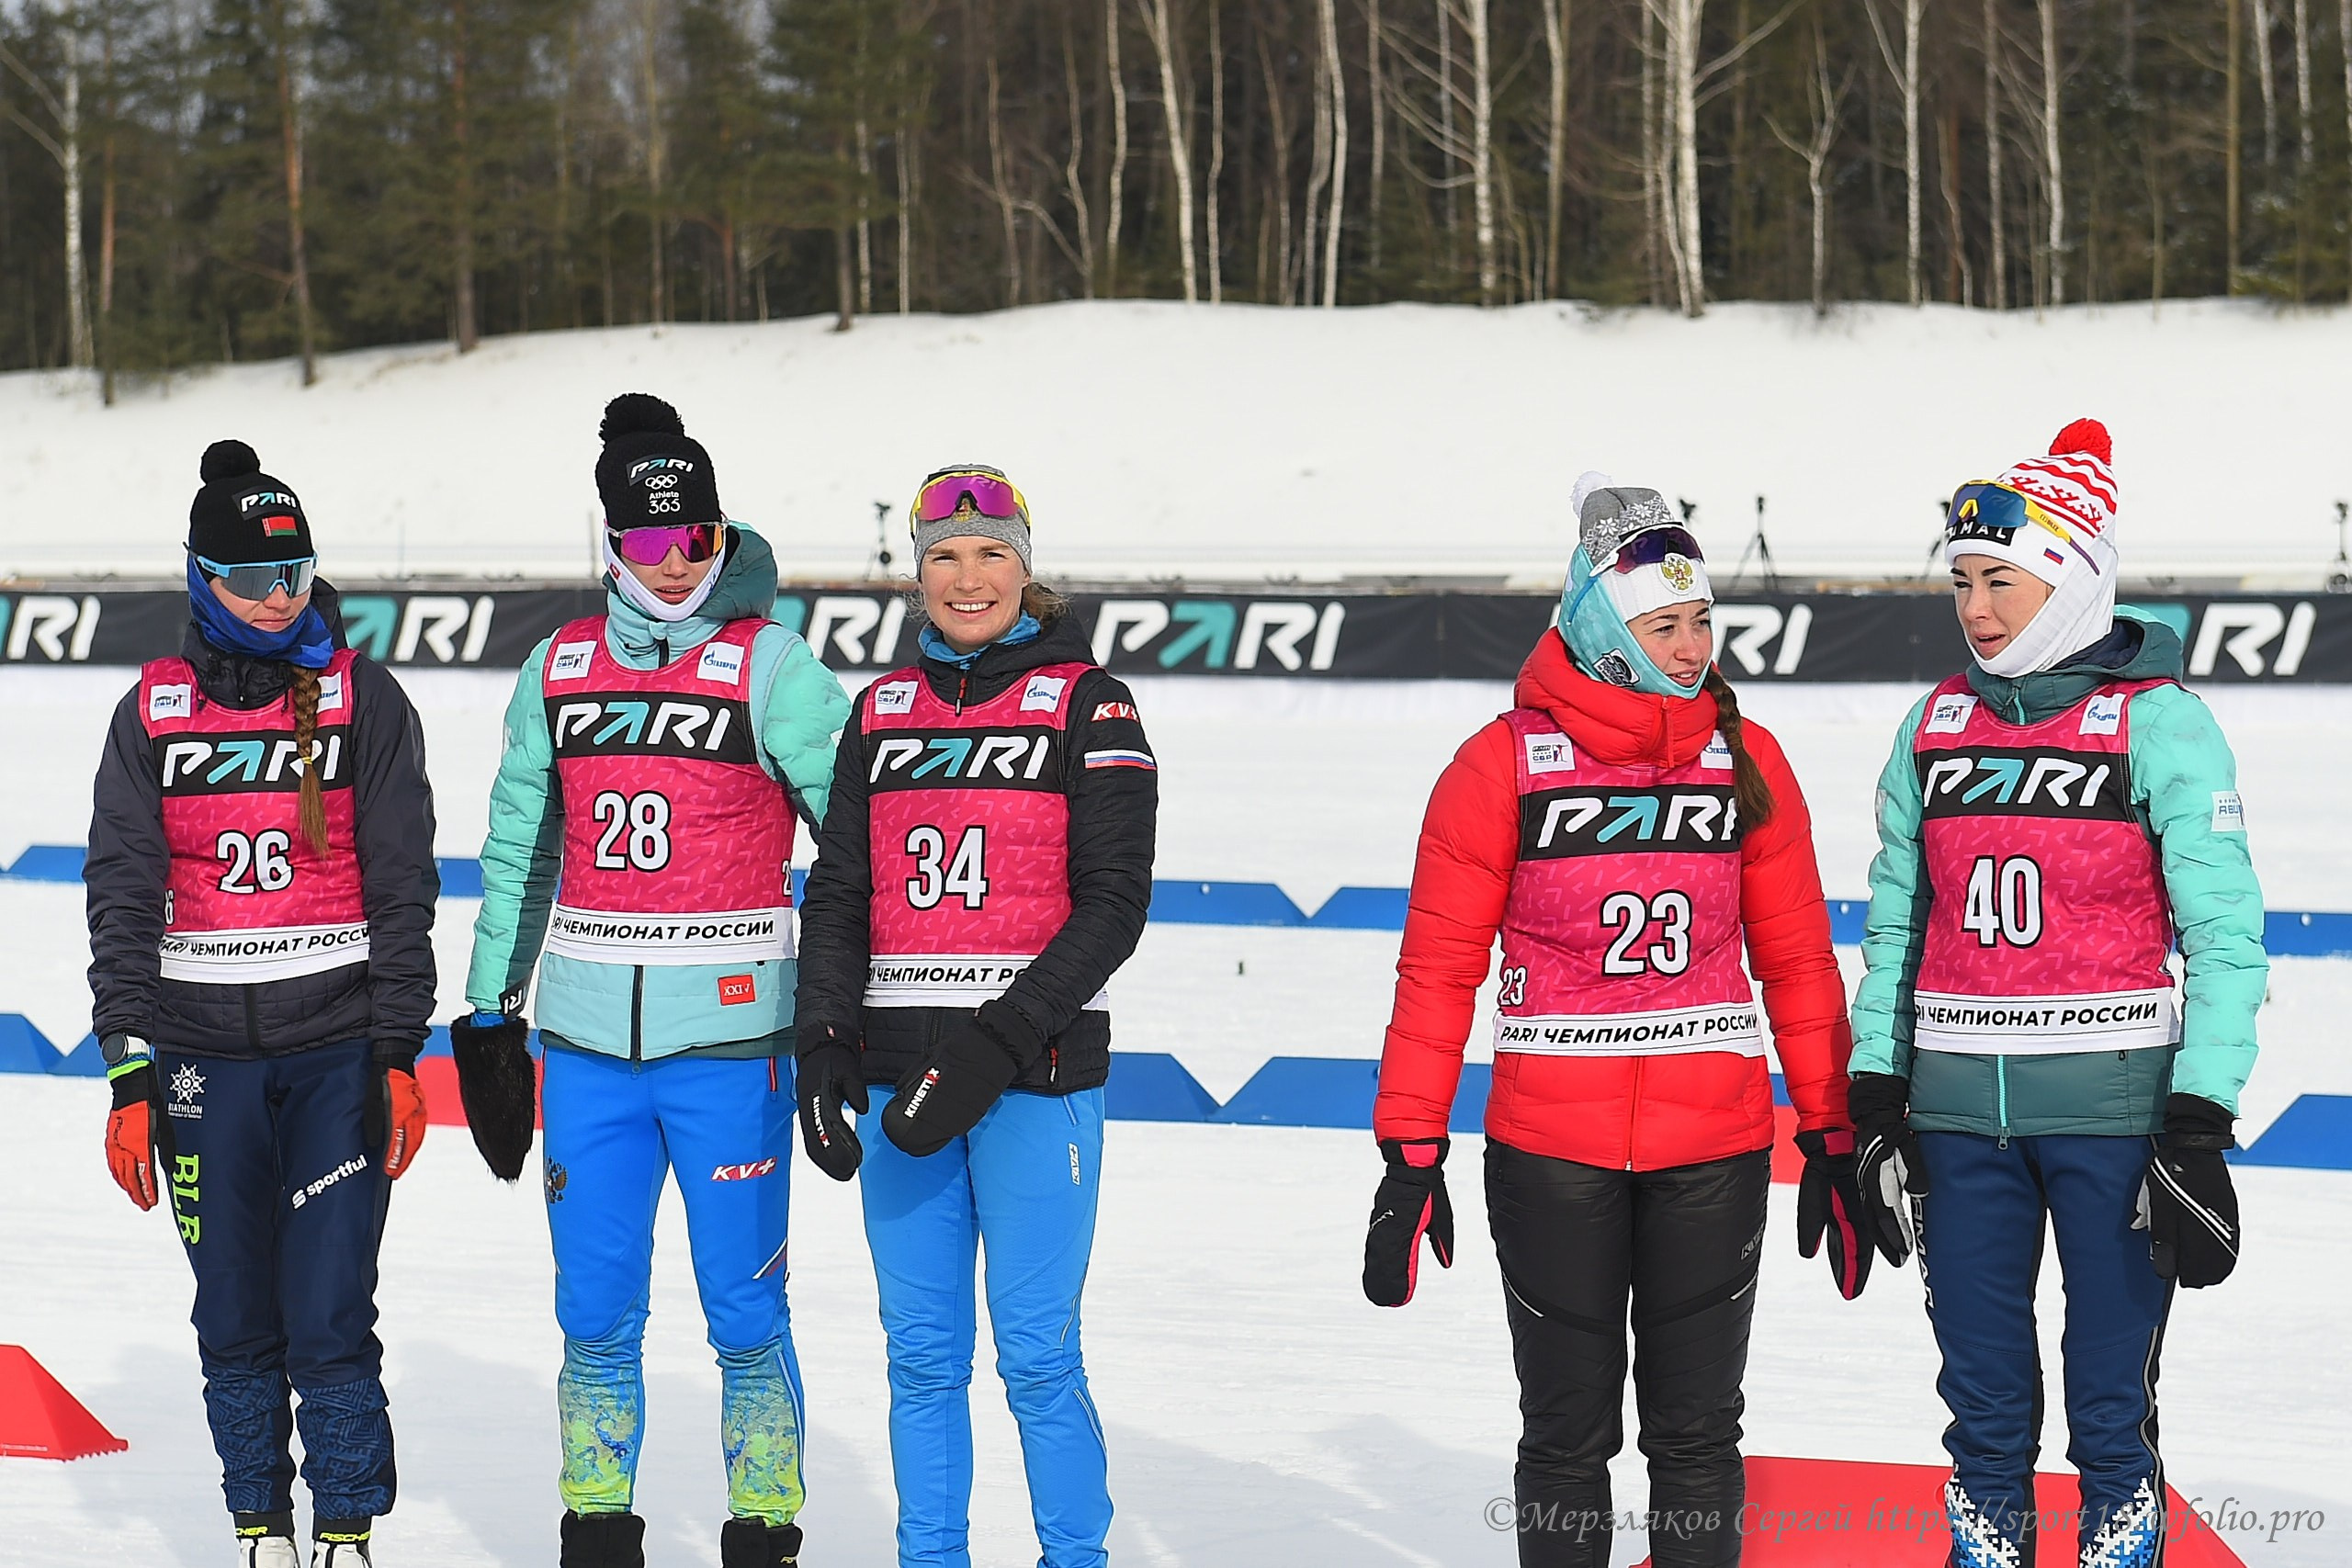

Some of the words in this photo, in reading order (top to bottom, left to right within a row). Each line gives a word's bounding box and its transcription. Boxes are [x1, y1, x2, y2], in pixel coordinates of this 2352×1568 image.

[630, 457, 694, 479] PARI
[241, 491, 297, 513] PARI
[648, 498, 681, 514] 365
[649, 491, 680, 501] Athlete
[0, 594, 101, 662] RI
[341, 595, 495, 662] ARI
[775, 595, 907, 665] RI
[1091, 599, 1346, 671] PARI
[2141, 601, 2317, 677] RI
[555, 701, 731, 751] PARI
[162, 734, 342, 787] PARI
[869, 735, 1049, 784] PARI
[1923, 756, 2110, 808] PARI
[593, 789, 672, 873] 28
[1536, 794, 1738, 850] PARI
[216, 828, 295, 895] 26
[782, 860, 792, 897] 2
[904, 823, 989, 911] 34
[164, 888, 175, 926] 6
[1962, 853, 2043, 949] 40
[190, 936, 304, 958] ЧЕМПИОНАТ
[563, 919, 681, 941] ЧЕМПИОНАТ
[684, 919, 775, 941] РОССИИ
[1598, 888, 1692, 978] 23
[876, 966, 997, 983] ЧЕМПИОНАТ
[1498, 965, 1528, 1008] 23
[1499, 1026, 1538, 1043] PARI
[1544, 1021, 1700, 1044] ЧЕМПИОНАТ
[1928, 1007, 2055, 1027] ЧЕМПИОНАТ
[2060, 1001, 2158, 1026] РОССИИ
[168, 1102, 203, 1114] BIATHLON
[903, 1067, 941, 1119] KINETIX
[812, 1095, 831, 1148] KINETIX
[306, 1153, 368, 1198] sportful
[711, 1156, 777, 1181] KV+
[172, 1153, 201, 1246] BLR
[235, 1525, 268, 1536] CHER
